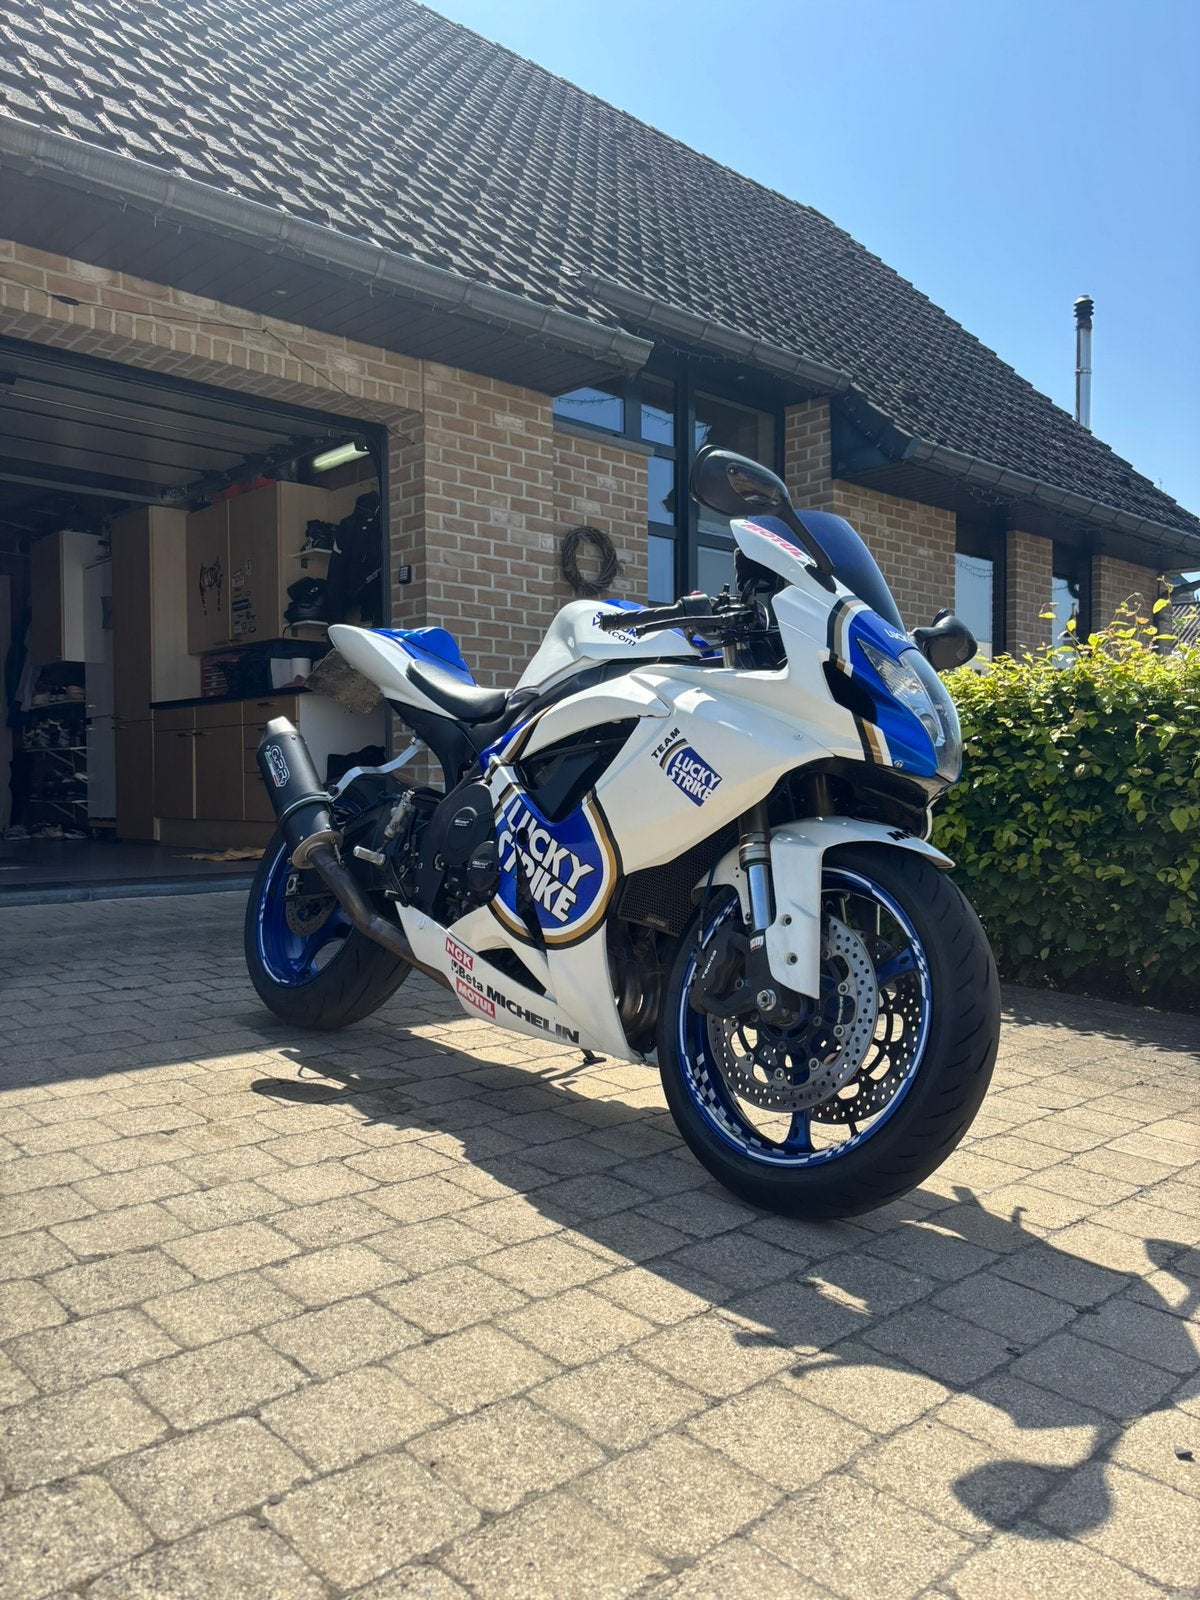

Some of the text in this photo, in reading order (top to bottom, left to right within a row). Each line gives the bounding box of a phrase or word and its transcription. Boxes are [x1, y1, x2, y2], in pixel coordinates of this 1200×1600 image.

[741, 524, 804, 558] MOTUL
[650, 727, 681, 759] TEAM
[668, 766, 712, 801] STRIKE
[674, 752, 721, 789] LUCKY
[506, 798, 595, 890] LUCKY
[446, 939, 473, 969] NGK
[458, 964, 484, 993] Beta
[457, 979, 495, 1017] MOTUL
[486, 984, 580, 1044] MICHELIN
